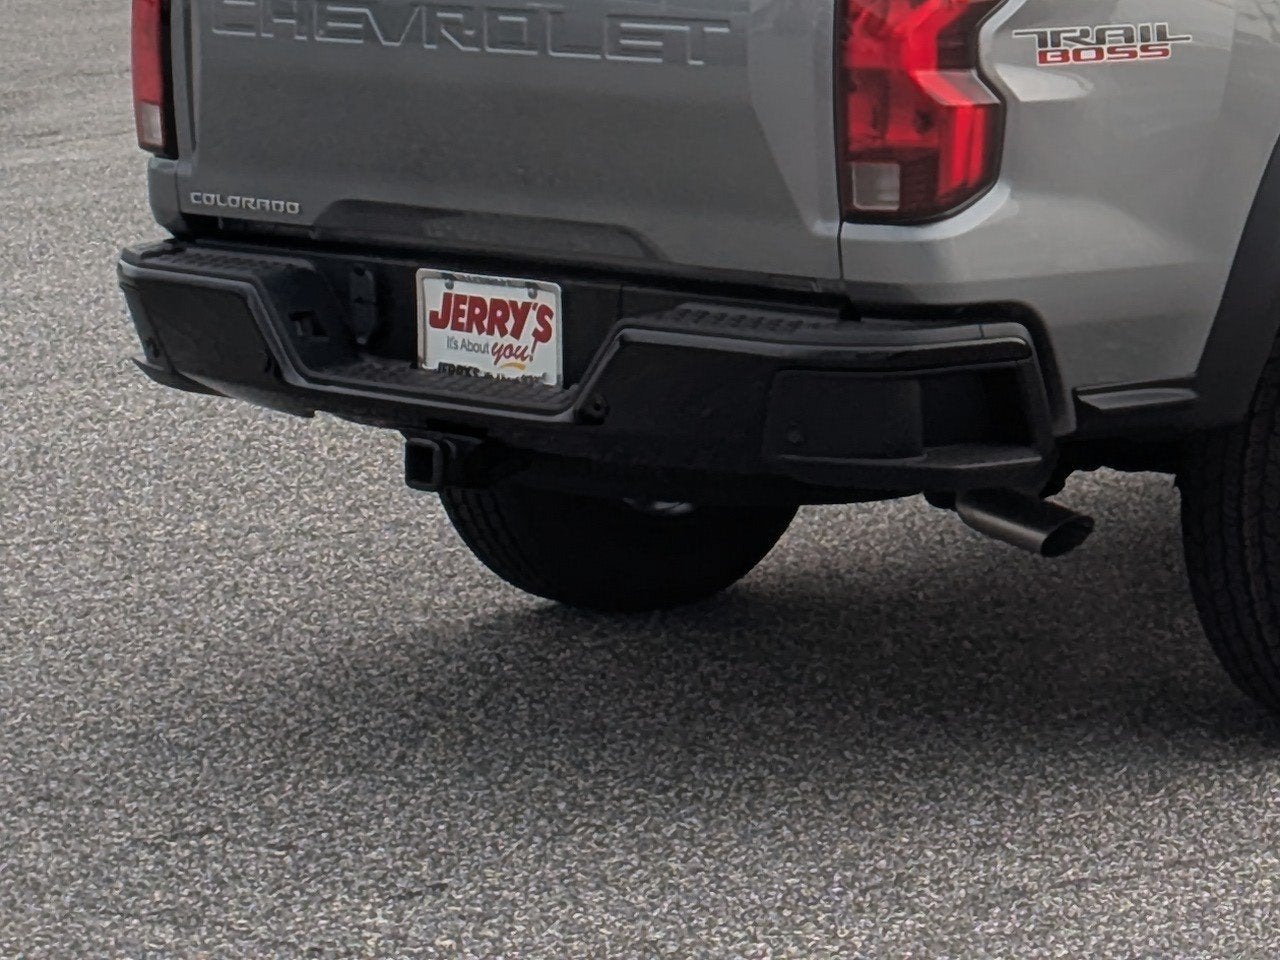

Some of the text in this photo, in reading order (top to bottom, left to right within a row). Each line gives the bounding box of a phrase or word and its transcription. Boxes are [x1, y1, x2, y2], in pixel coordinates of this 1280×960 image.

[1012, 22, 1192, 49] TRAIL
[1037, 43, 1171, 66] BOSS
[189, 191, 300, 215] COLORADO
[429, 292, 554, 344] JERRY'S
[446, 335, 538, 366] It's About you!
